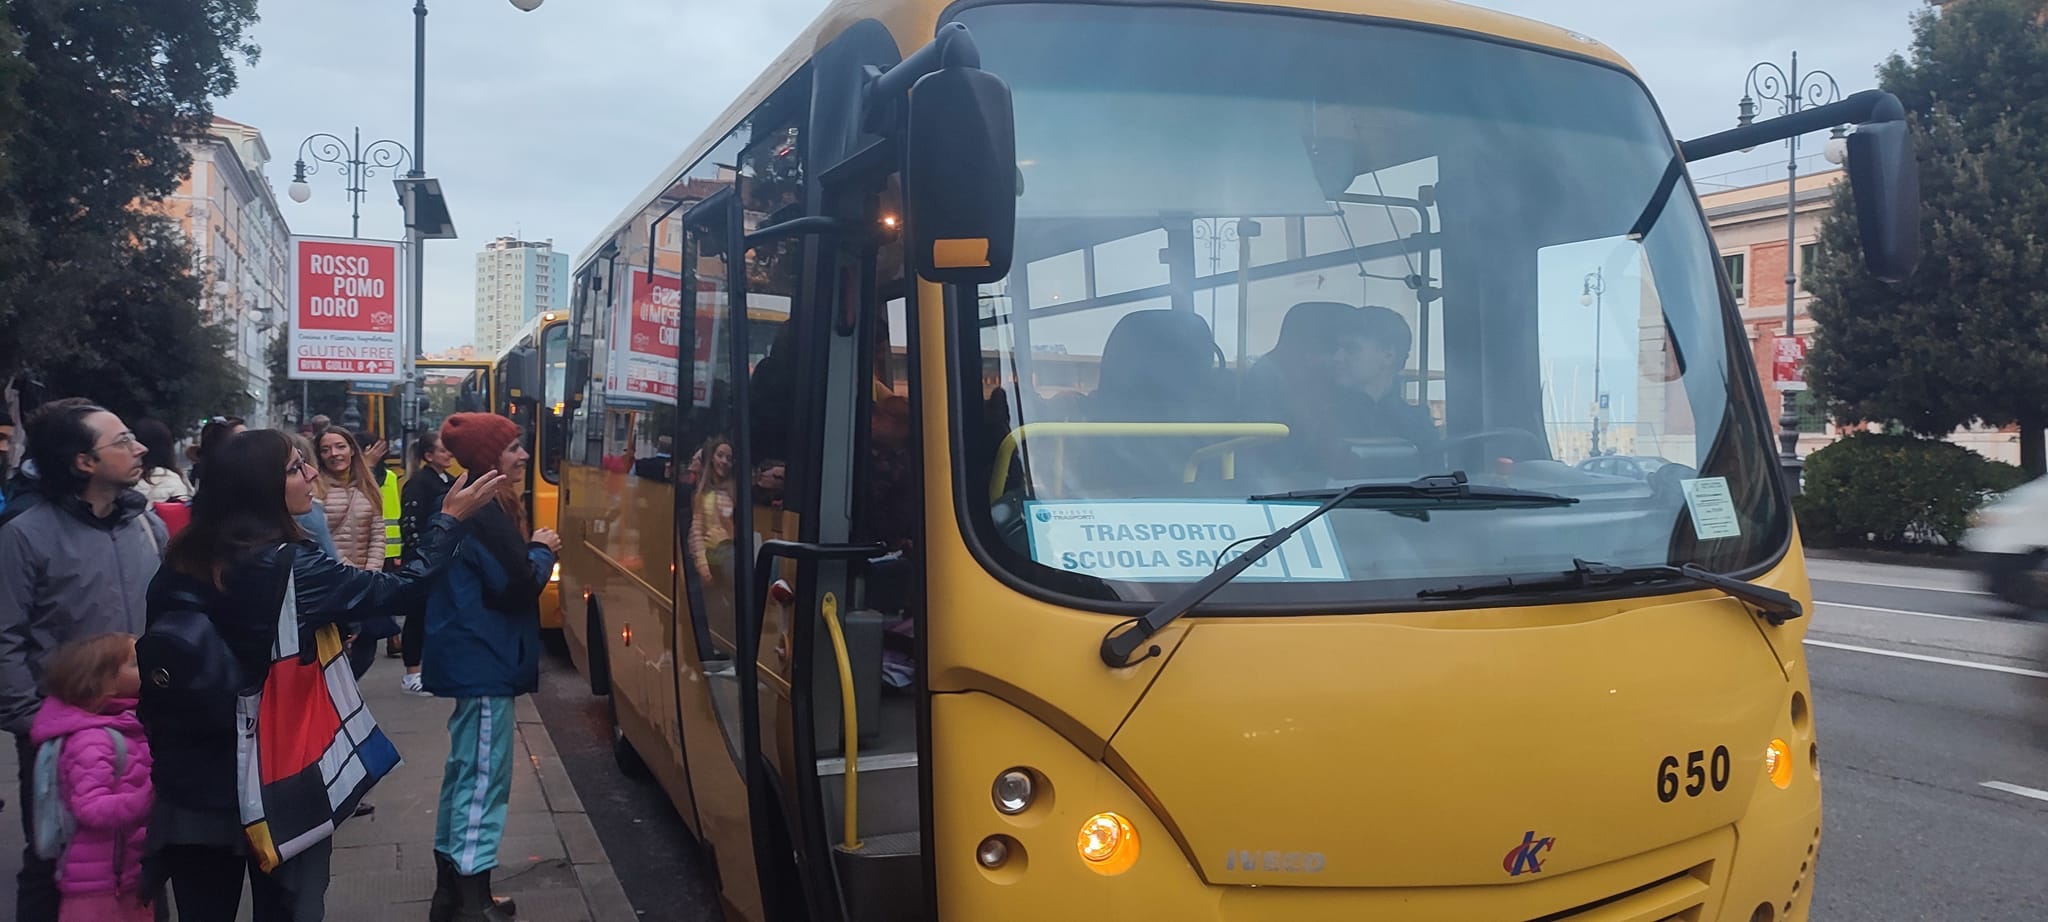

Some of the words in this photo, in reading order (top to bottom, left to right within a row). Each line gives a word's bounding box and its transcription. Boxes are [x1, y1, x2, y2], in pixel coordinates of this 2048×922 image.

[310, 254, 369, 276] ROSSO
[334, 277, 384, 298] POMO
[310, 296, 359, 318] DORO
[297, 344, 357, 357] GLUTEN
[361, 347, 393, 359] FREE
[300, 360, 323, 370] RIVA
[1080, 523, 1236, 542] TRASPORTO
[1063, 549, 1169, 570] SCUOLA
[1657, 745, 1731, 803] 650
[1226, 848, 1326, 872] IVECO
